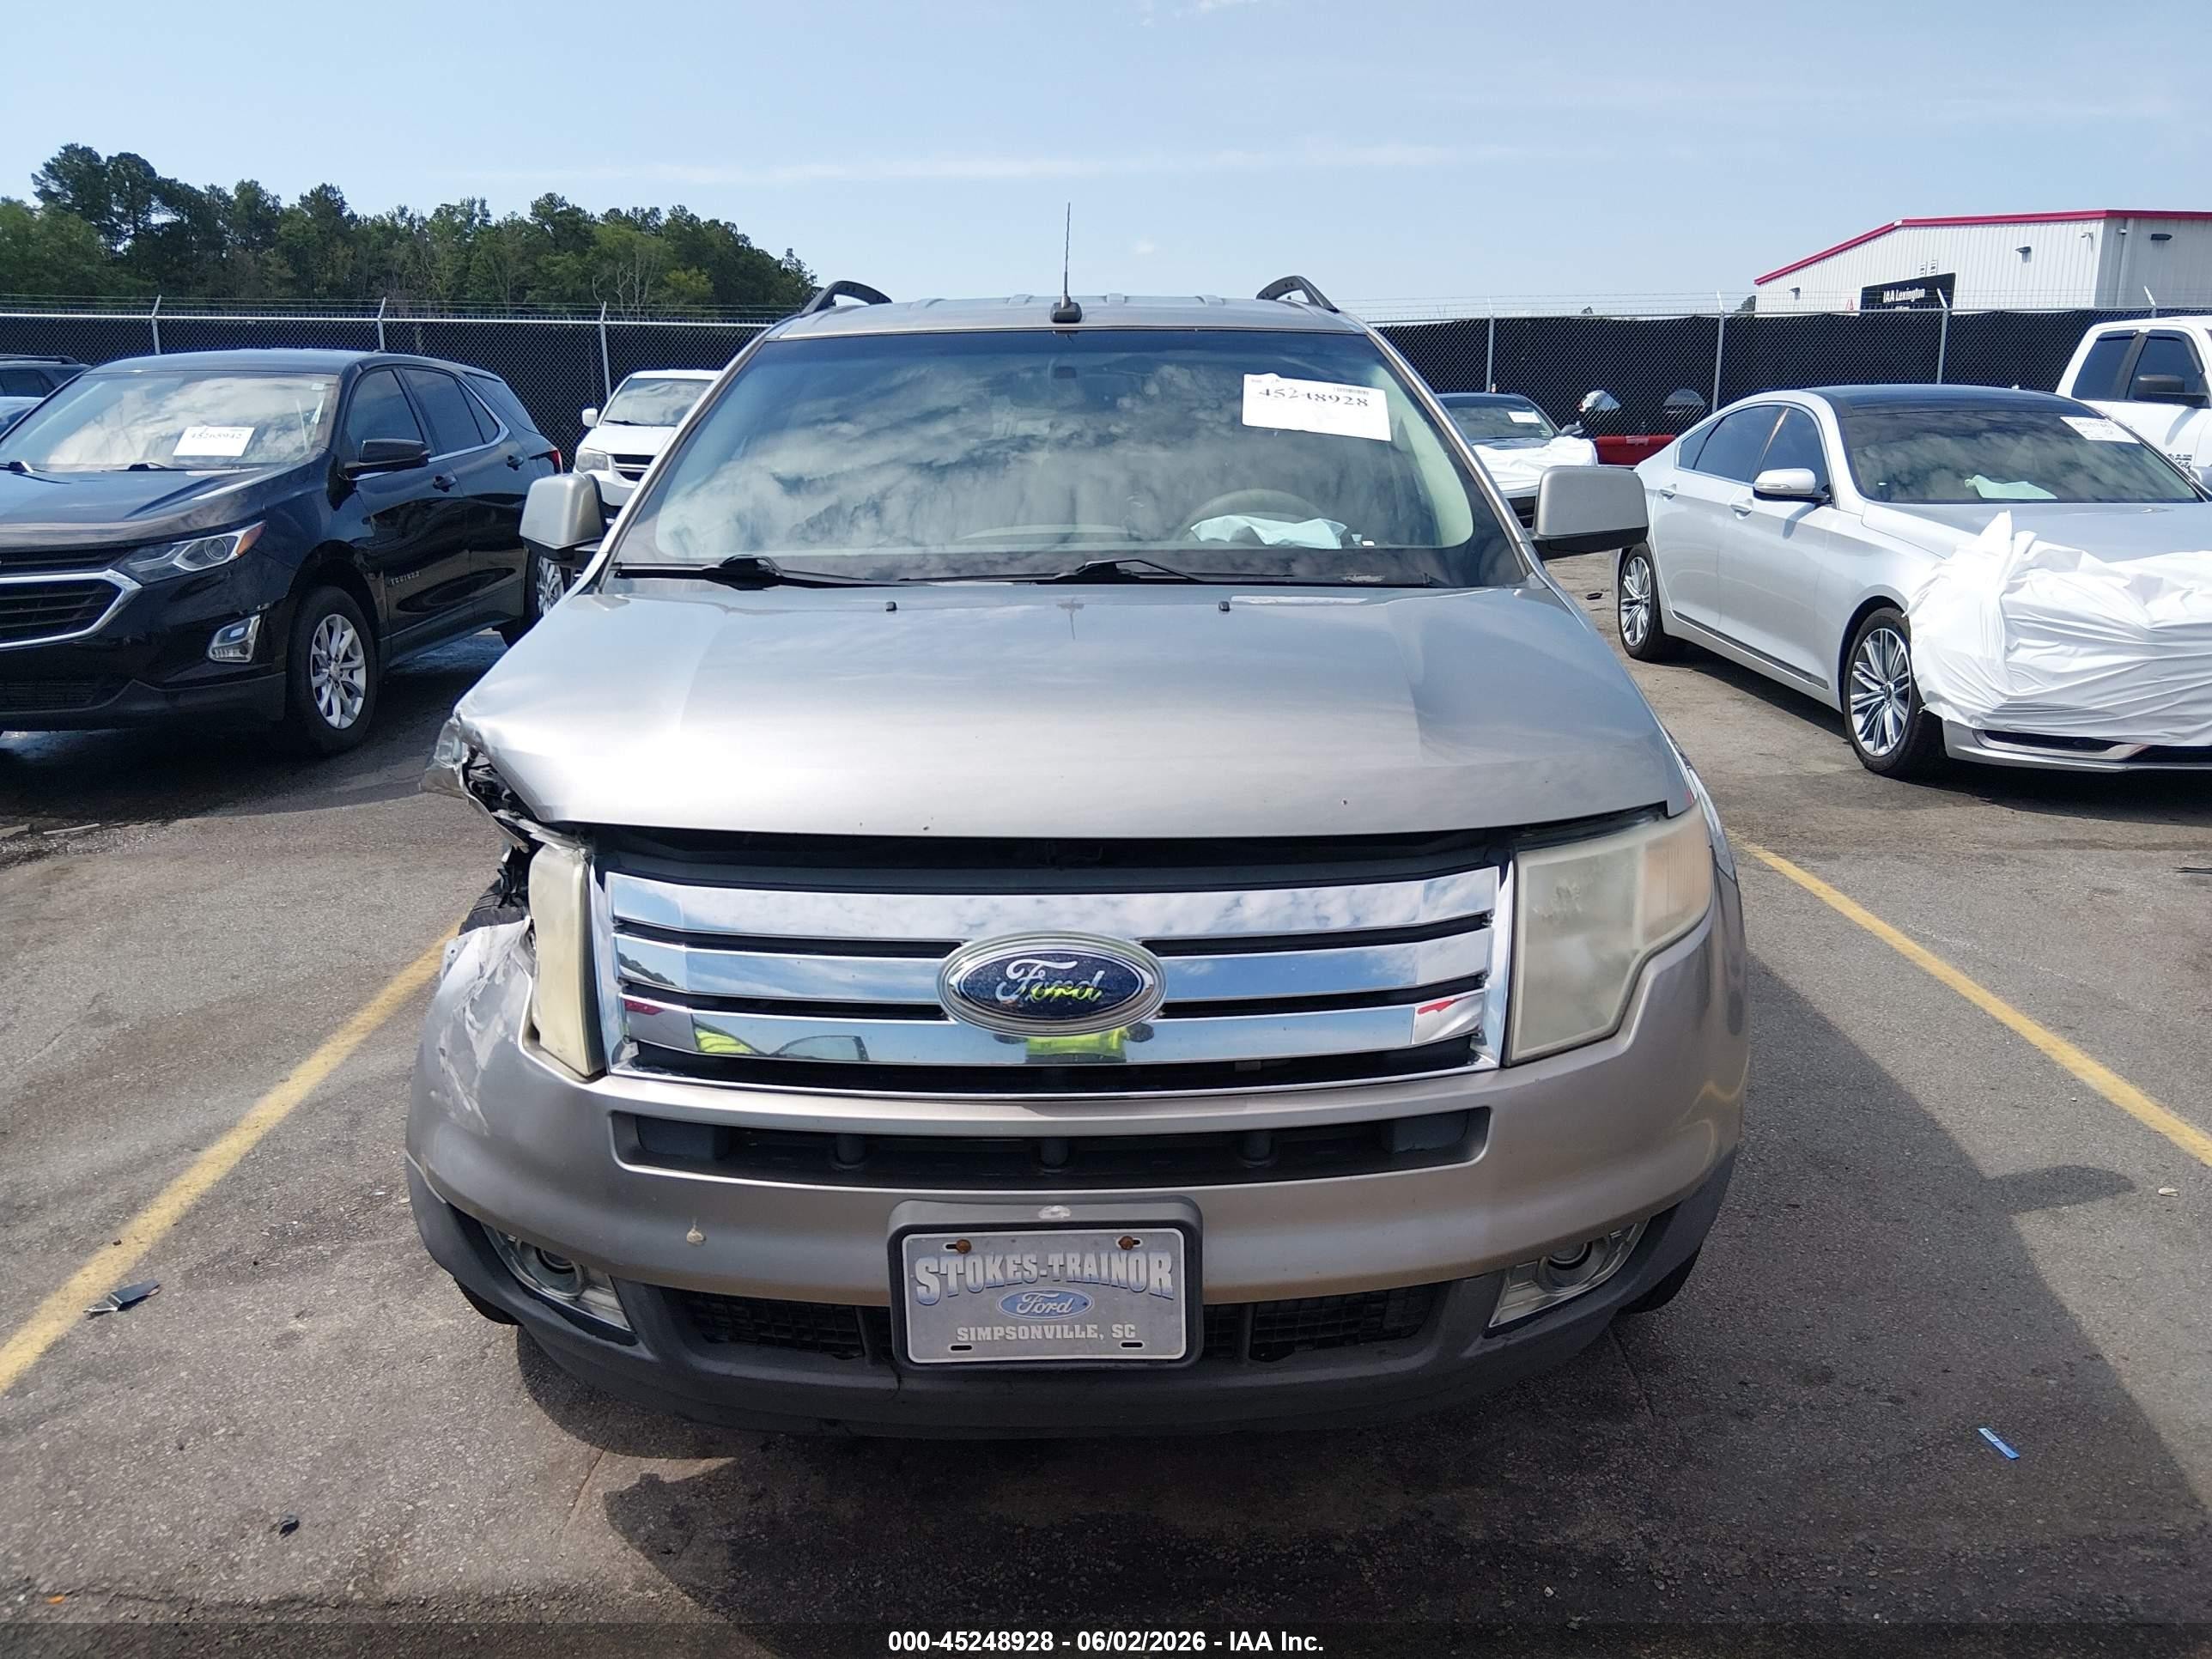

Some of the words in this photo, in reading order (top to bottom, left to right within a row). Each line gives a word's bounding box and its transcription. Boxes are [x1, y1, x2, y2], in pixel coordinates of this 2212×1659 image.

[1883, 289, 1894, 303] IAA
[1895, 287, 1925, 302] Lexington
[1259, 386, 1369, 407] 45248928
[995, 958, 1105, 1003] Ford
[914, 1249, 1176, 1306] STOKES-TRAINOR
[1016, 1291, 1073, 1315] Ford
[956, 1324, 1105, 1342] SIMPSONVILLE,
[1111, 1323, 1137, 1340] SC
